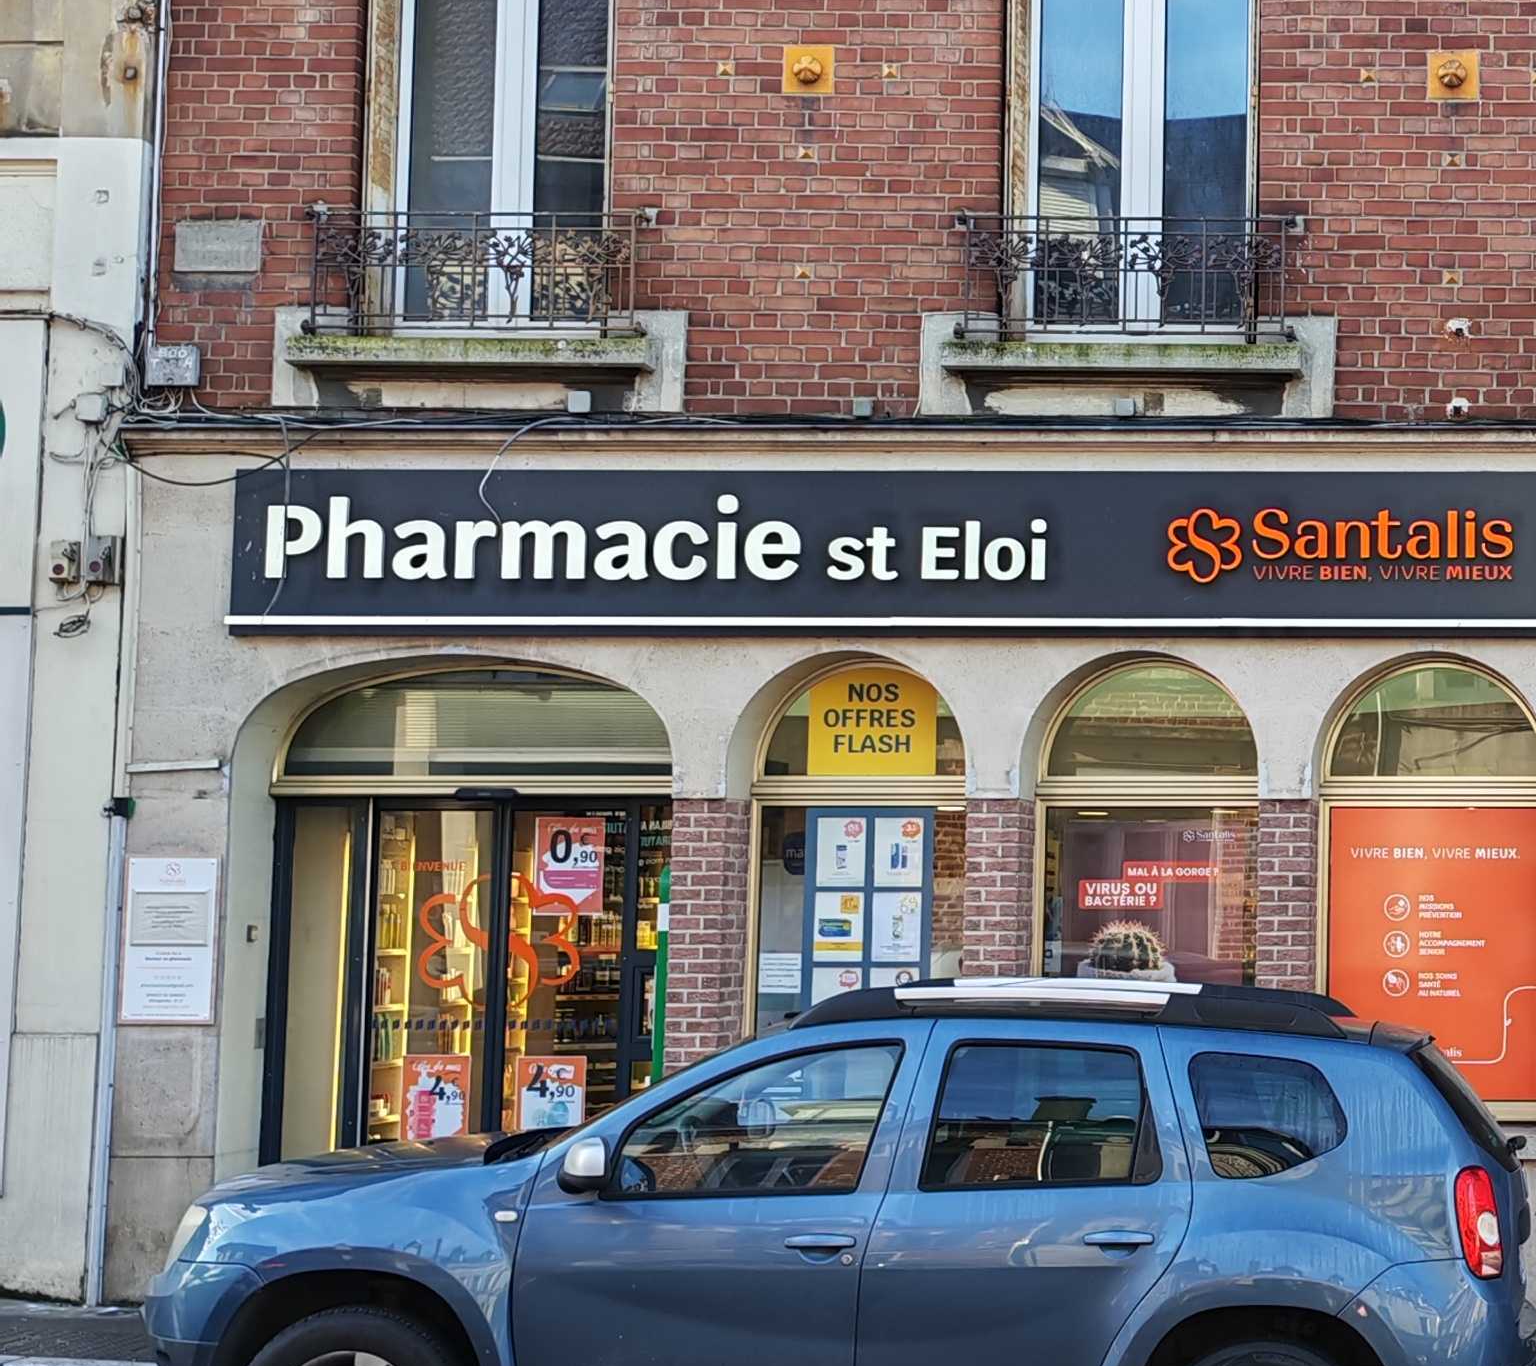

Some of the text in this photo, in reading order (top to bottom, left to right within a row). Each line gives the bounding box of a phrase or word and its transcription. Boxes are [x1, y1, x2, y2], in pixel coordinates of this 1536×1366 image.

[265, 495, 1048, 581] Pharmacie st Eloi
[1252, 508, 1515, 561] Santalis
[1253, 564, 1513, 584] VIVRE BIEN, VIVRE MIEUX
[847, 683, 899, 704] NOS
[822, 708, 917, 729] OFFRES
[833, 733, 912, 755] FLASH
[1350, 847, 1389, 859] VIVRE
[1393, 847, 1427, 860] BIEN,
[1432, 847, 1471, 859] VIVRE
[400, 859, 466, 872] BENVENUE
[1127, 867, 1148, 877] MAL
[1151, 865, 1159, 876] À
[1161, 868, 1173, 877] LA
[1176, 867, 1210, 877] GORGE
[1086, 882, 1157, 895] VIRUS OU
[1085, 892, 1157, 907] BACTÉRIE ?
